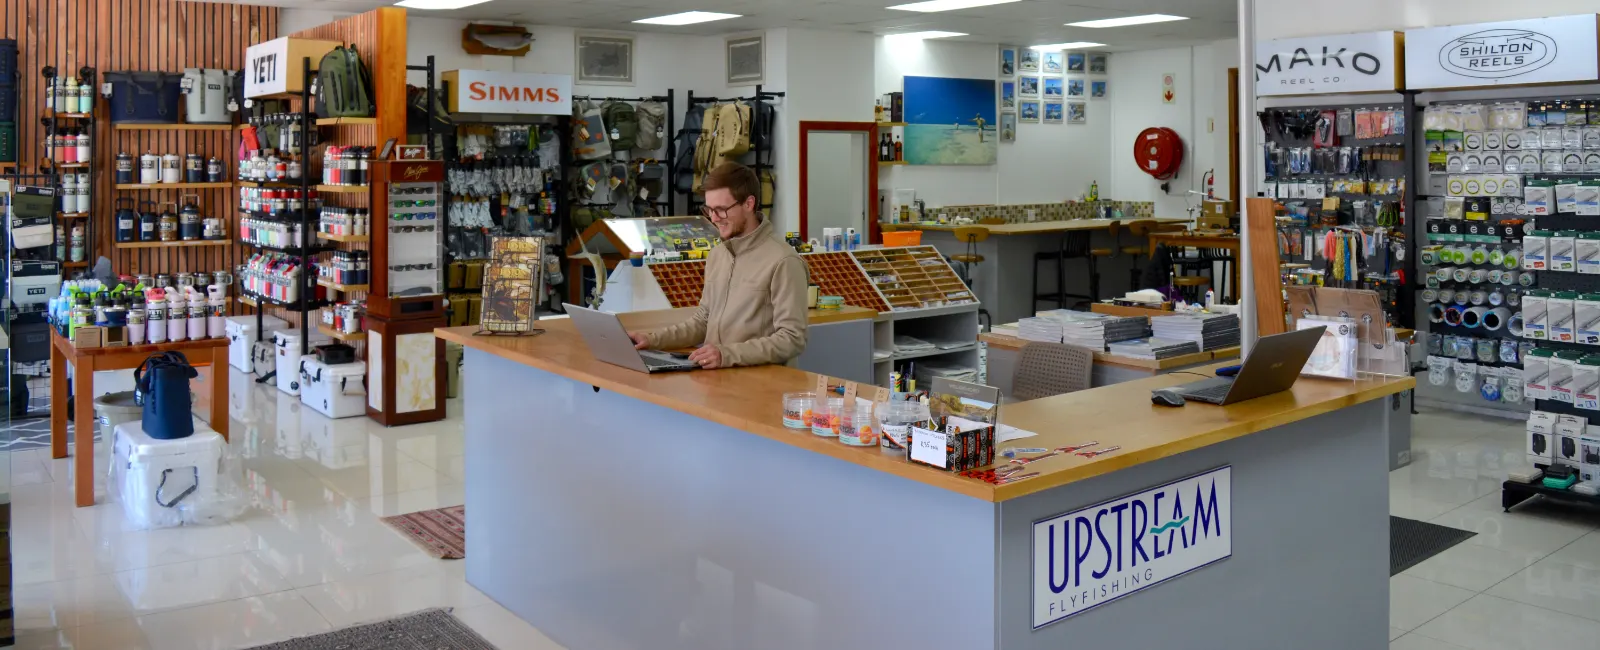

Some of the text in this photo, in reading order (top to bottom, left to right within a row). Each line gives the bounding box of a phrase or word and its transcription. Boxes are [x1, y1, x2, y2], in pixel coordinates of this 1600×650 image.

[1256, 46, 1380, 82] MAKO
[1460, 43, 1533, 56] SHILTON
[1469, 56, 1524, 68] REELS
[253, 53, 277, 84] YETI
[469, 81, 560, 103] SIMMS
[1049, 477, 1221, 594] UPSTREAM
[1049, 568, 1153, 616] FLYFISHING
